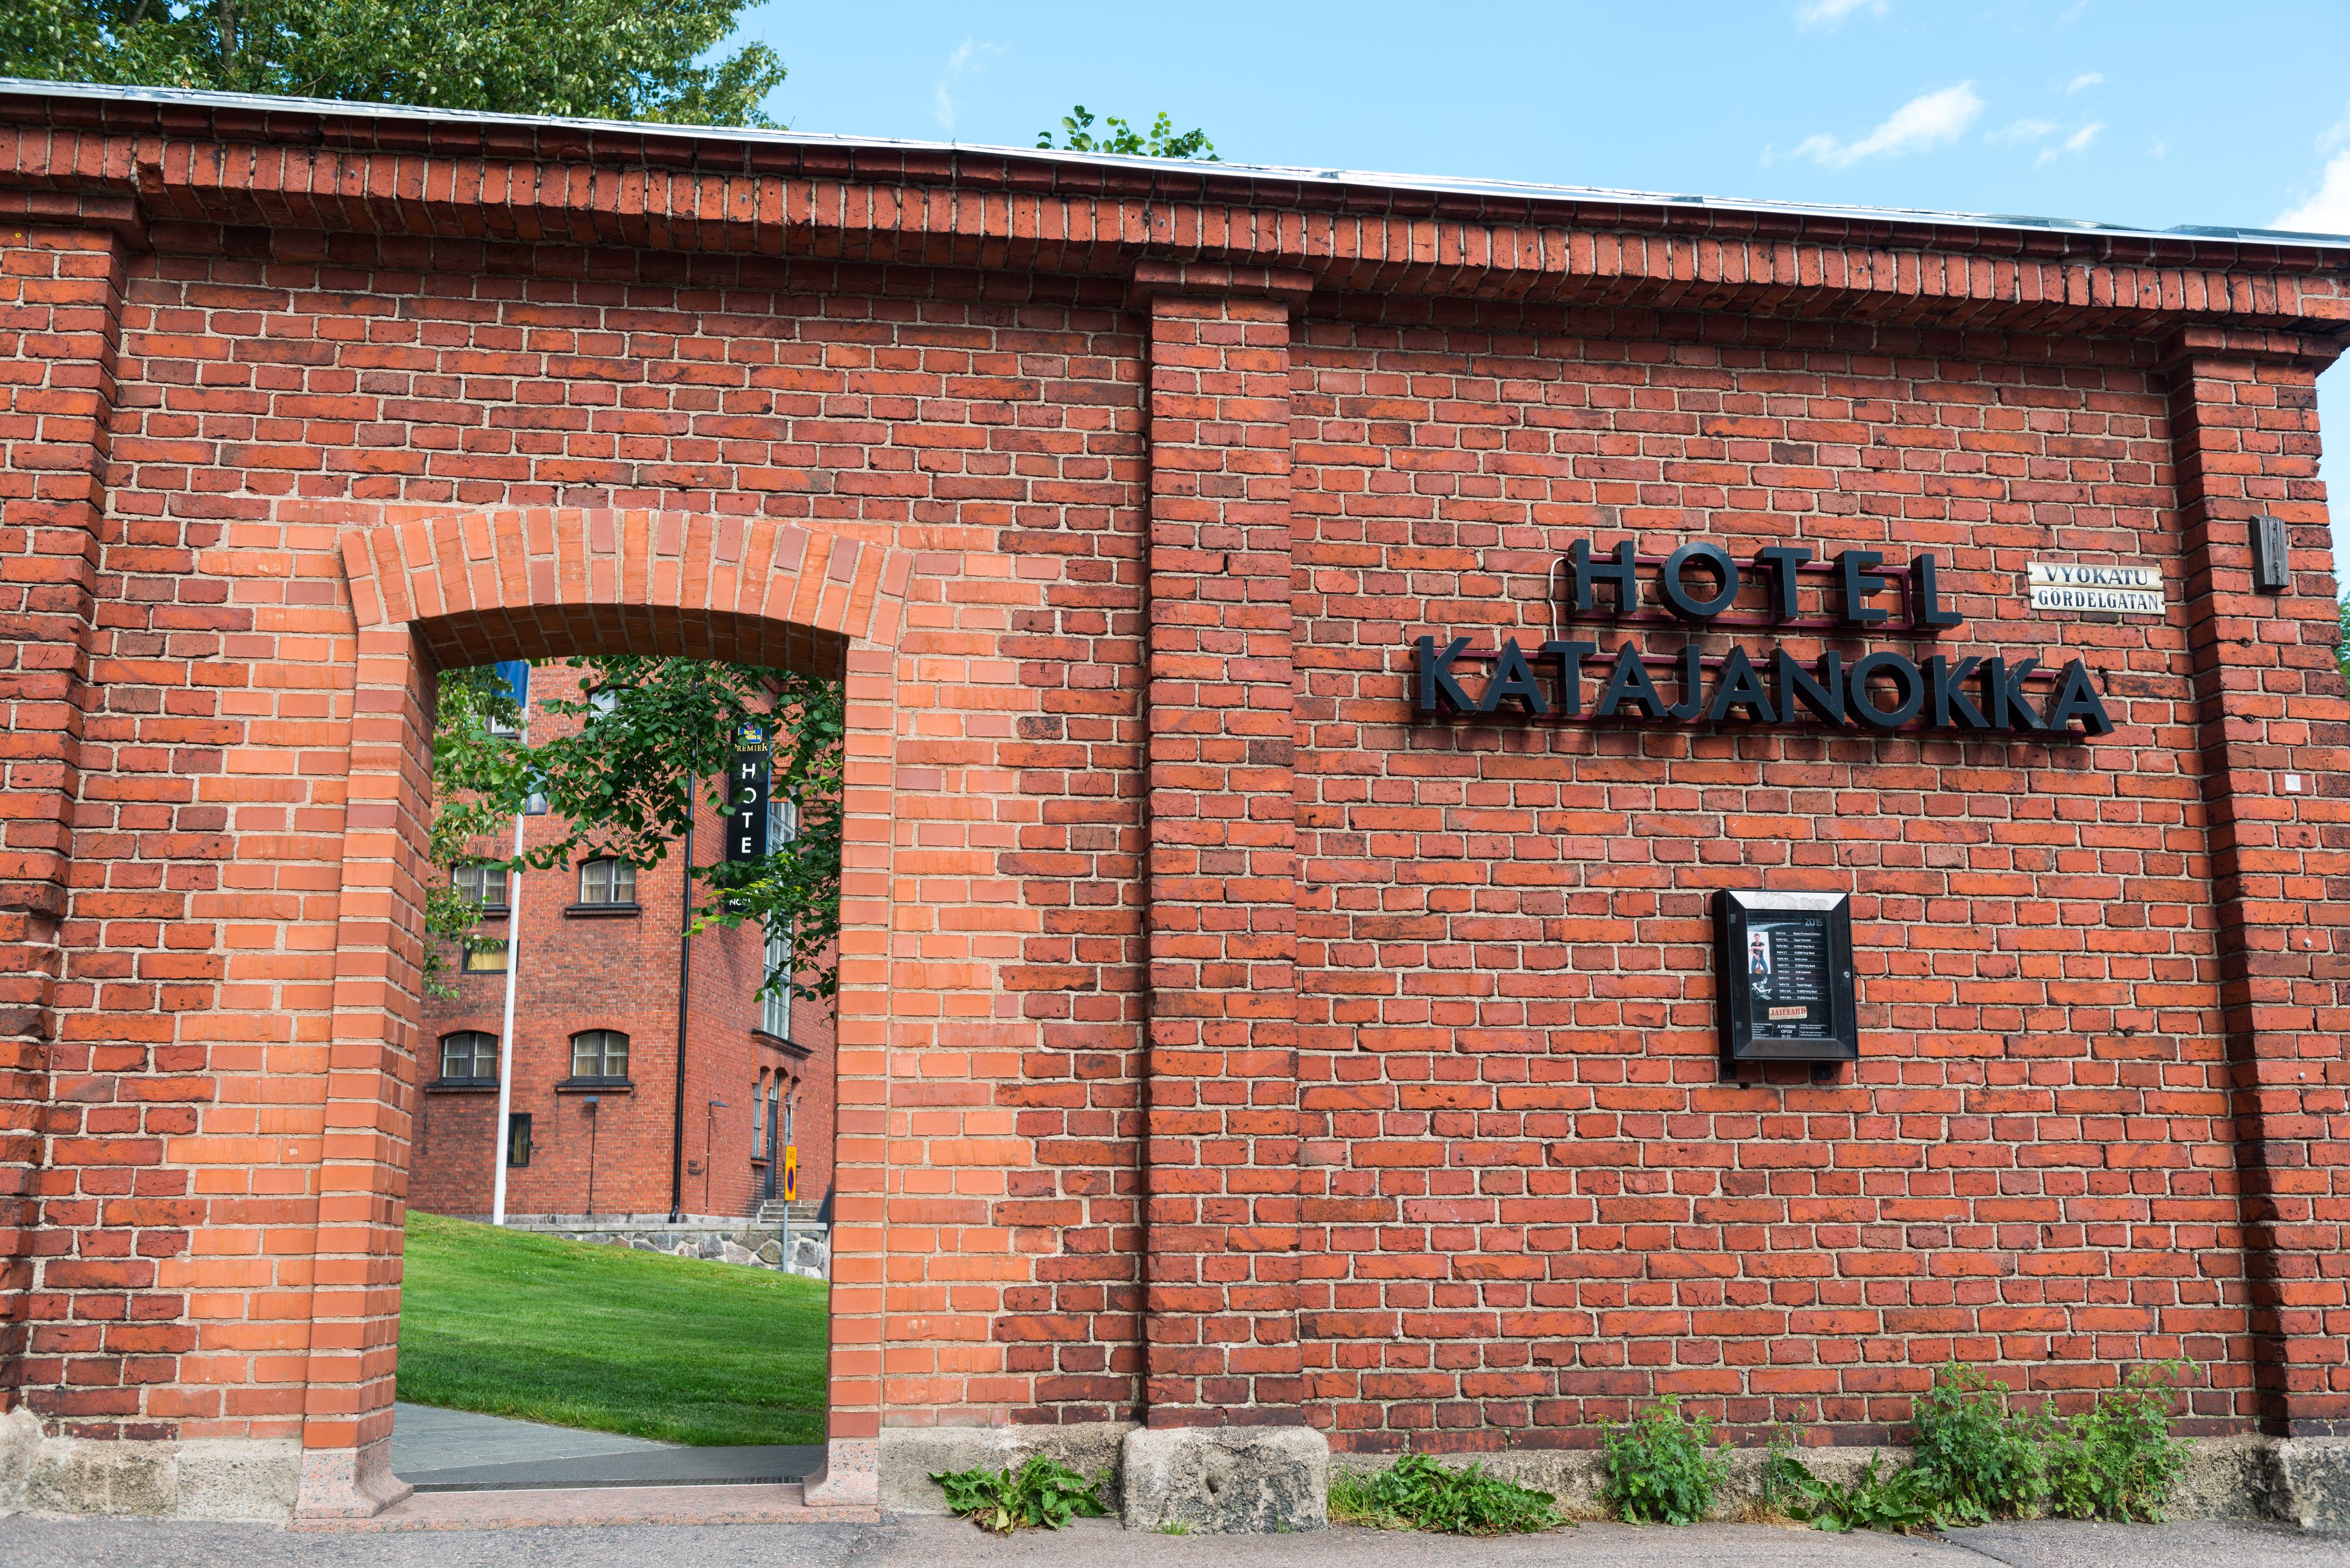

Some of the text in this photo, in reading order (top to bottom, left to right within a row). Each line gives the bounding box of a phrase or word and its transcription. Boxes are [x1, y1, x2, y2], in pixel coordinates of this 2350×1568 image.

[1569, 539, 1963, 629] HOTEL
[2039, 588, 2159, 611] GÖRDELGATAN
[2043, 566, 2148, 586] VYOKATU
[1414, 635, 2114, 734] KATAJANOKKA
[742, 763, 757, 854] HOTE
[1804, 918, 1823, 927] 2015
